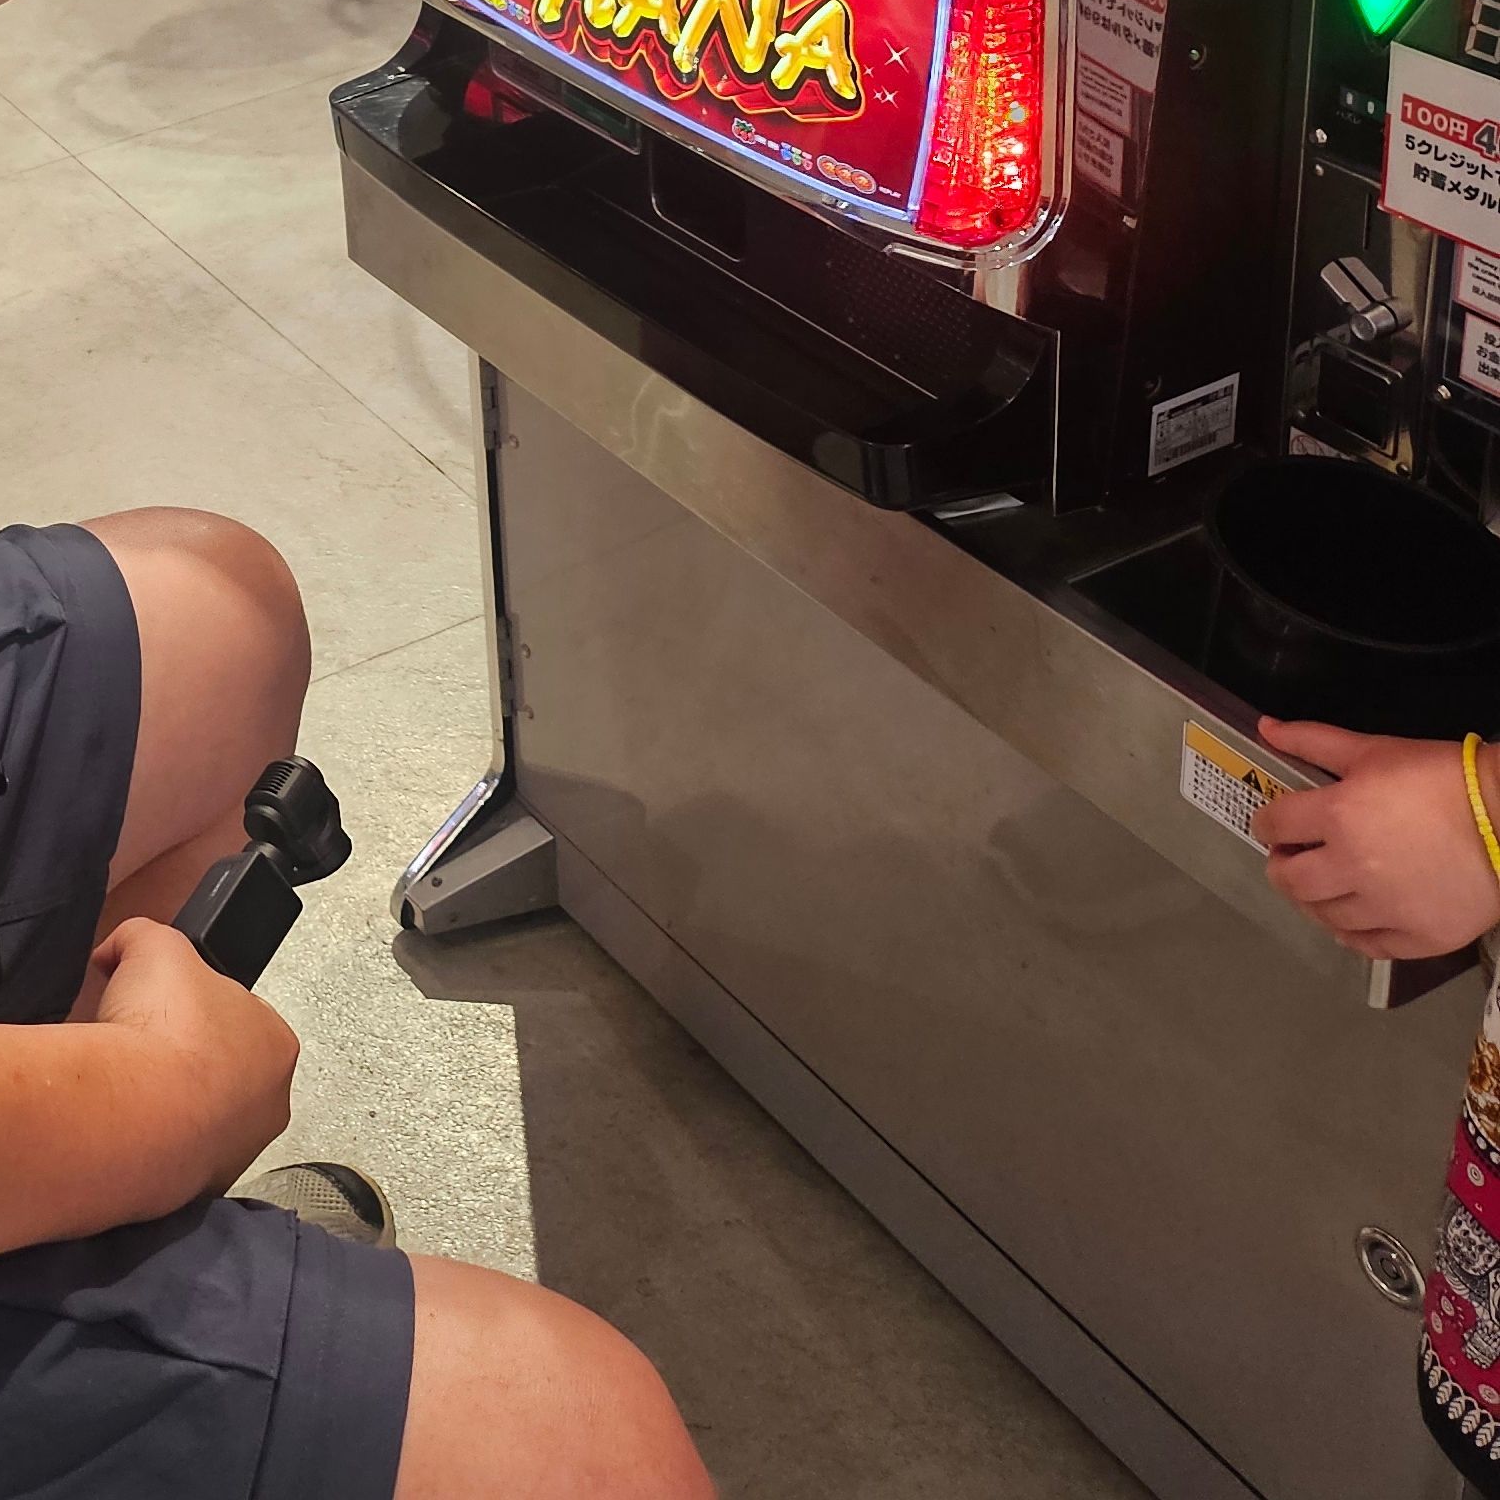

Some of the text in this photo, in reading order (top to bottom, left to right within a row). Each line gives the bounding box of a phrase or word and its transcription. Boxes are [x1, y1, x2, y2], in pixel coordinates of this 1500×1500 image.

[1412, 162, 1500, 214] 貯蓄メダル
